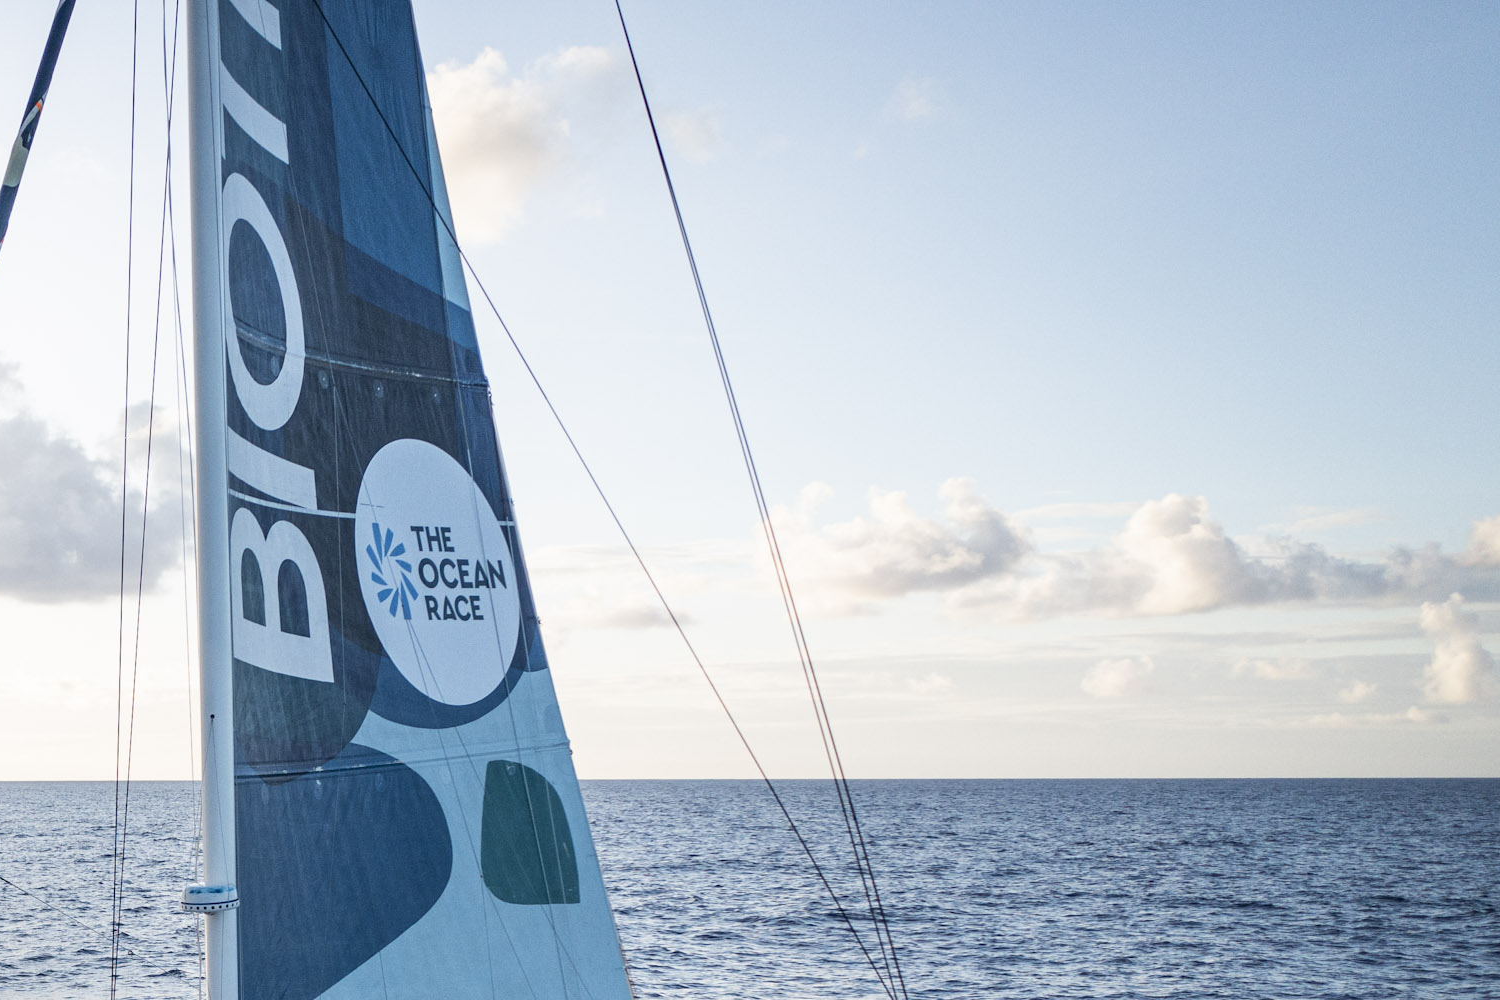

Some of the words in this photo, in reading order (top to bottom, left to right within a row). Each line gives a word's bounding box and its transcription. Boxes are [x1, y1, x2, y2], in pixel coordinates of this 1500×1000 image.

[220, 0, 335, 684] BIOT
[410, 525, 455, 553] THE
[418, 557, 507, 590] OCEAN
[424, 595, 485, 622] RACE
